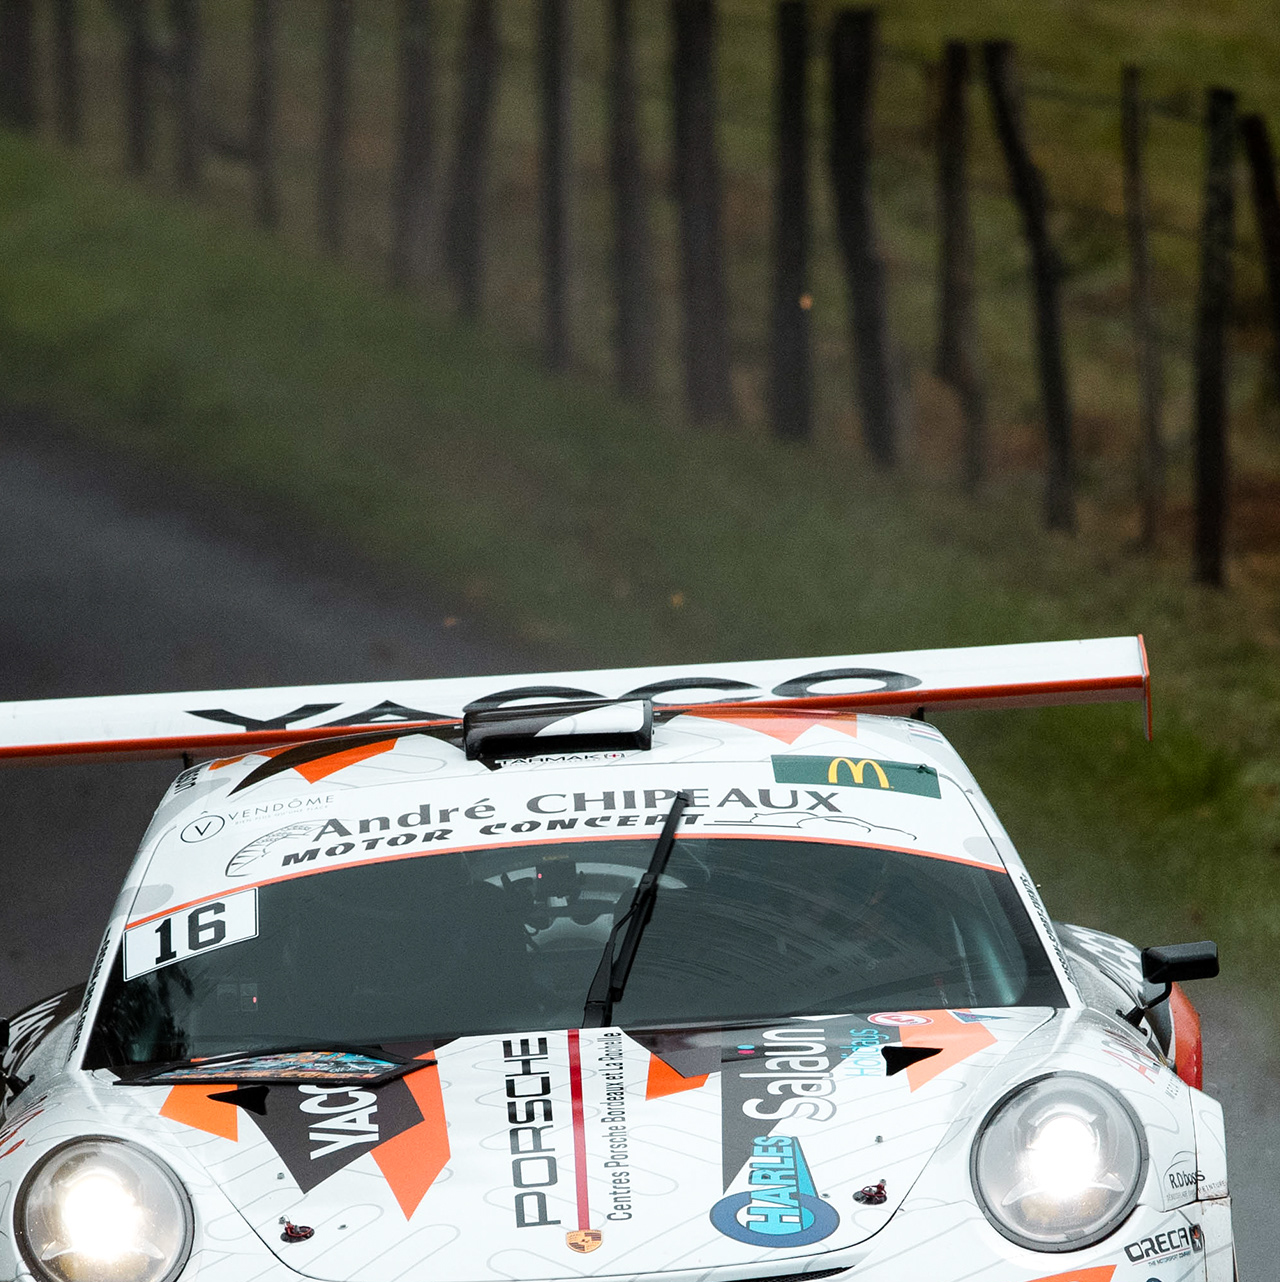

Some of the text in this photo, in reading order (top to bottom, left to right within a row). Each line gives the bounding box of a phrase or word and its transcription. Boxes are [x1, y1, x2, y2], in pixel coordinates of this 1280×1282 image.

[228, 794, 336, 821] VENDÔME
[312, 797, 496, 843] André
[526, 787, 844, 815] CHIPEAUX
[281, 828, 454, 867] MOTOR
[154, 901, 226, 965] 16
[297, 1084, 379, 1161] YAC
[503, 1036, 562, 1229] PORSCHE
[596, 1032, 633, 1222] Centres Porsche Bordeaux et La Rochelle
[1124, 1226, 1190, 1263] ORECA
